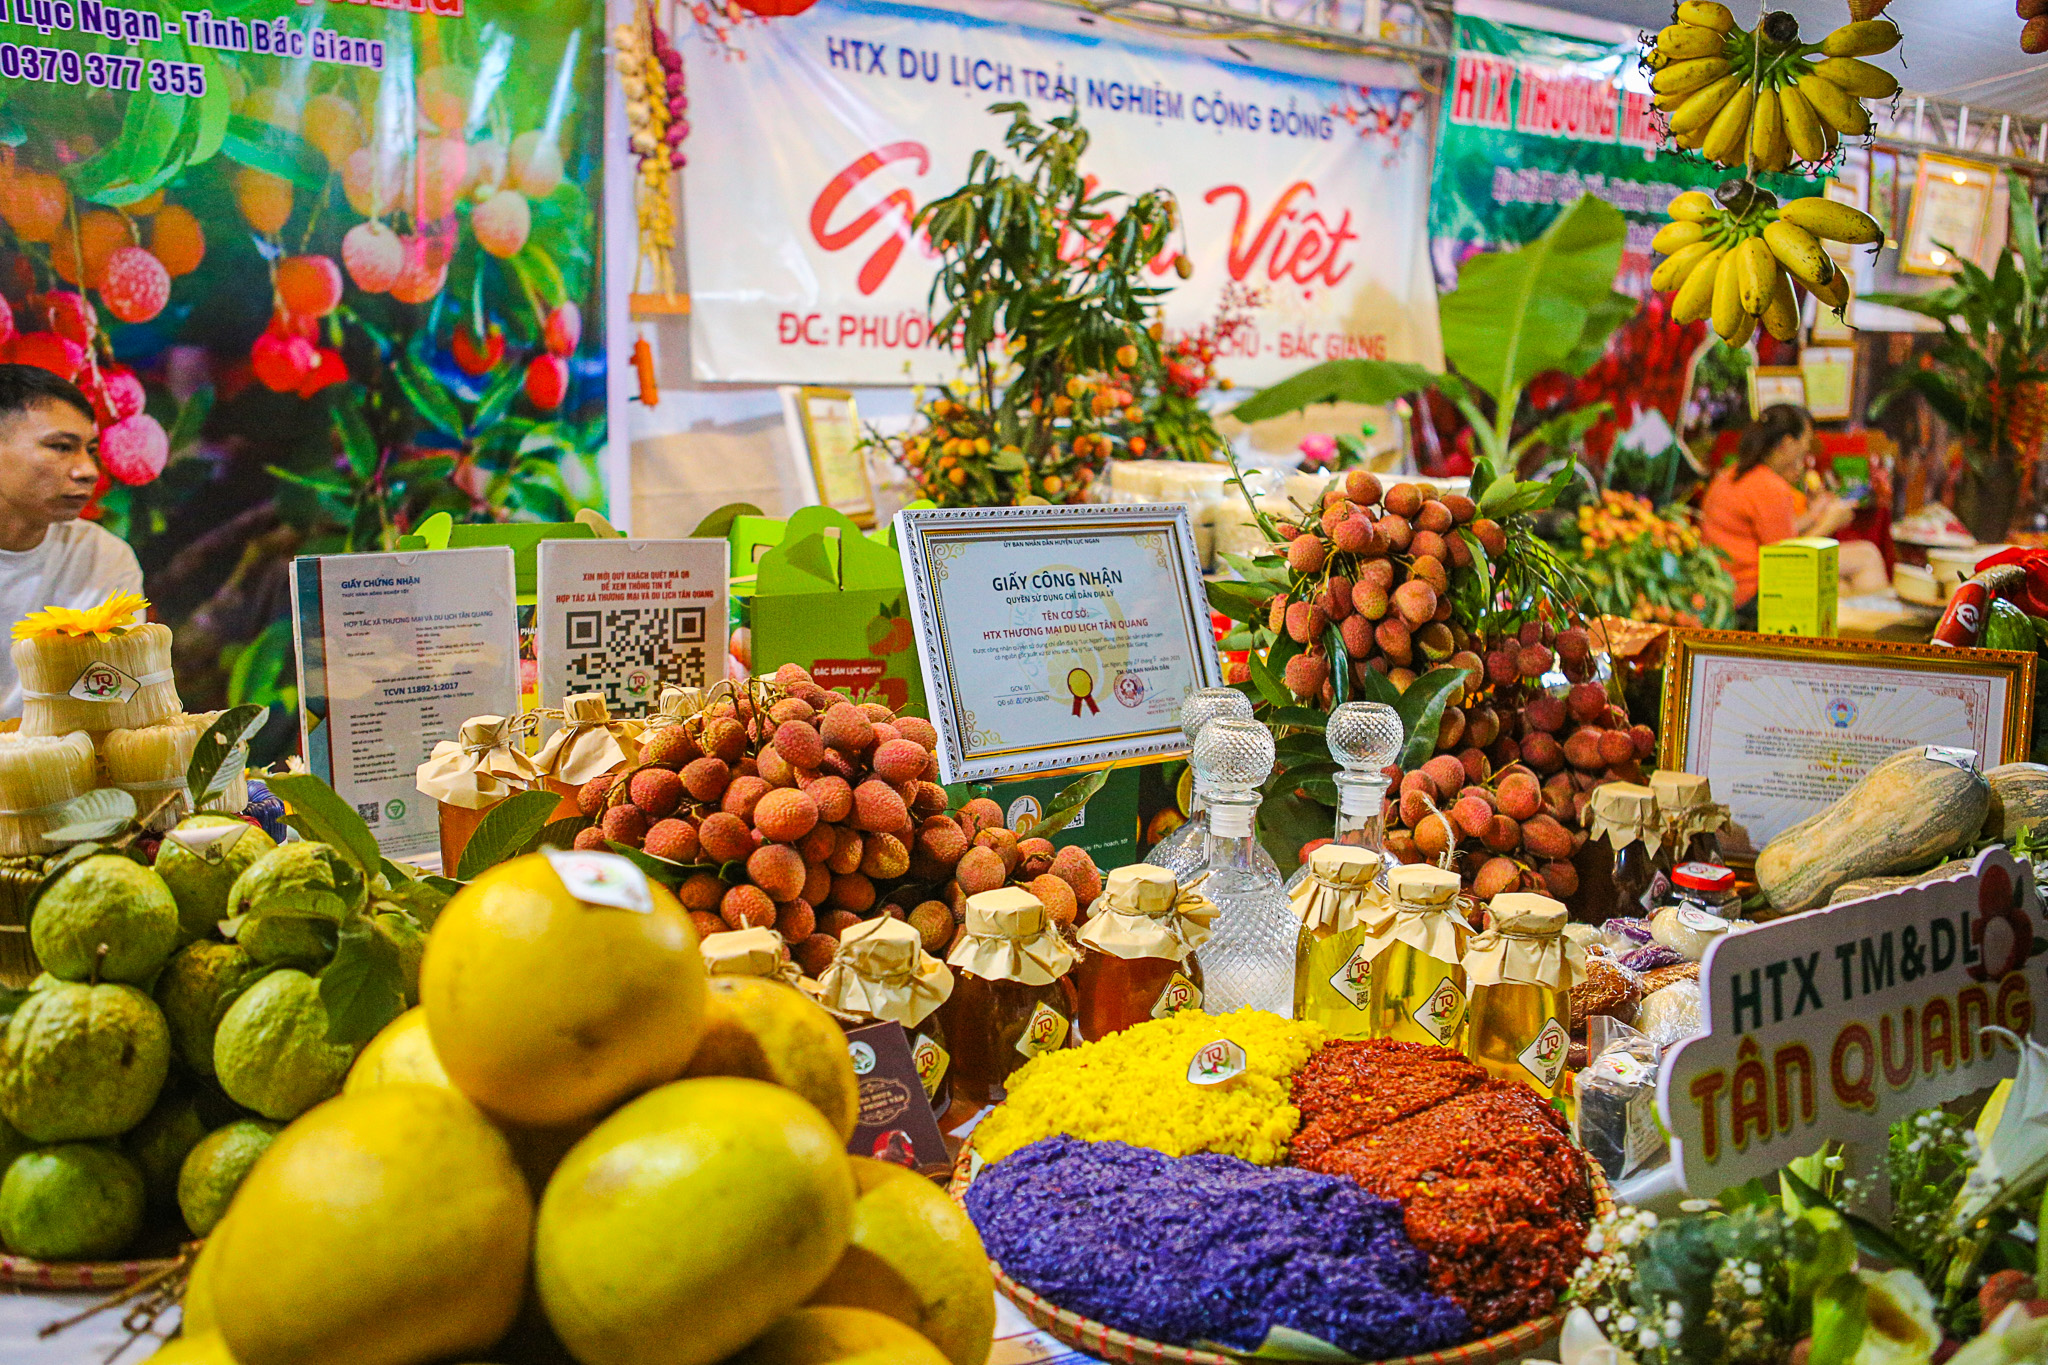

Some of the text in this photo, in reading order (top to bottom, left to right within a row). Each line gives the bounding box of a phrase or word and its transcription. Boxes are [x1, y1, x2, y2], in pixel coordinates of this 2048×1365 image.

[17, 0, 73, 34] Lục
[80, 0, 161, 44] Ngạn
[185, 11, 248, 49] Tỉnh
[254, 18, 304, 56] Bắc
[313, 31, 384, 68] Giang
[1, 44, 205, 96] 0379 377 355
[826, 35, 887, 76] HTX
[898, 47, 939, 82] DU
[950, 54, 1014, 97] LỊCH
[1086, 79, 1185, 125] NGHIỆM
[1191, 90, 1262, 134] CỘNG
[1268, 97, 1334, 141] ĐỒNG
[1451, 52, 1514, 130] HTX
[1204, 181, 1359, 299] Việt
[777, 312, 828, 346] ĐC:
[1278, 324, 1320, 360] BẮC
[1324, 333, 1388, 362] GIANG
[341, 576, 420, 589] GIẤY CHỨNG NHẬN
[583, 573, 595, 581] XIN
[627, 570, 649, 579] KHÁCH
[992, 567, 1122, 592] GIẤY CÔNG NHẬN
[629, 581, 650, 590] THÔNG
[573, 593, 585, 602] TÁC
[1006, 593, 1030, 605] QUYỀN
[1043, 593, 1063, 602] DỤNG
[1042, 610, 1059, 620] TÊN
[1061, 611, 1073, 619] CƠ
[983, 618, 1148, 640] HTX THƯƠNG MẠI DU LỊCH TÂN QUANG
[92, 673, 113, 687] TQ
[632, 675, 646, 687] TQ
[383, 682, 458, 696] TCVN 11892-1:2017
[1355, 961, 1370, 974] TQ
[1731, 911, 1979, 1035] HTX TM&DL
[1173, 988, 1187, 1001] TQ
[1439, 994, 1453, 1007] TQ
[1038, 1018, 1052, 1033] TQ
[1545, 1035, 1559, 1048] TQ
[920, 1051, 934, 1066] TQ
[1205, 1047, 1223, 1062] TQ
[1689, 1033, 1816, 1163] TÂN
[1829, 971, 2035, 1113] QUANG
